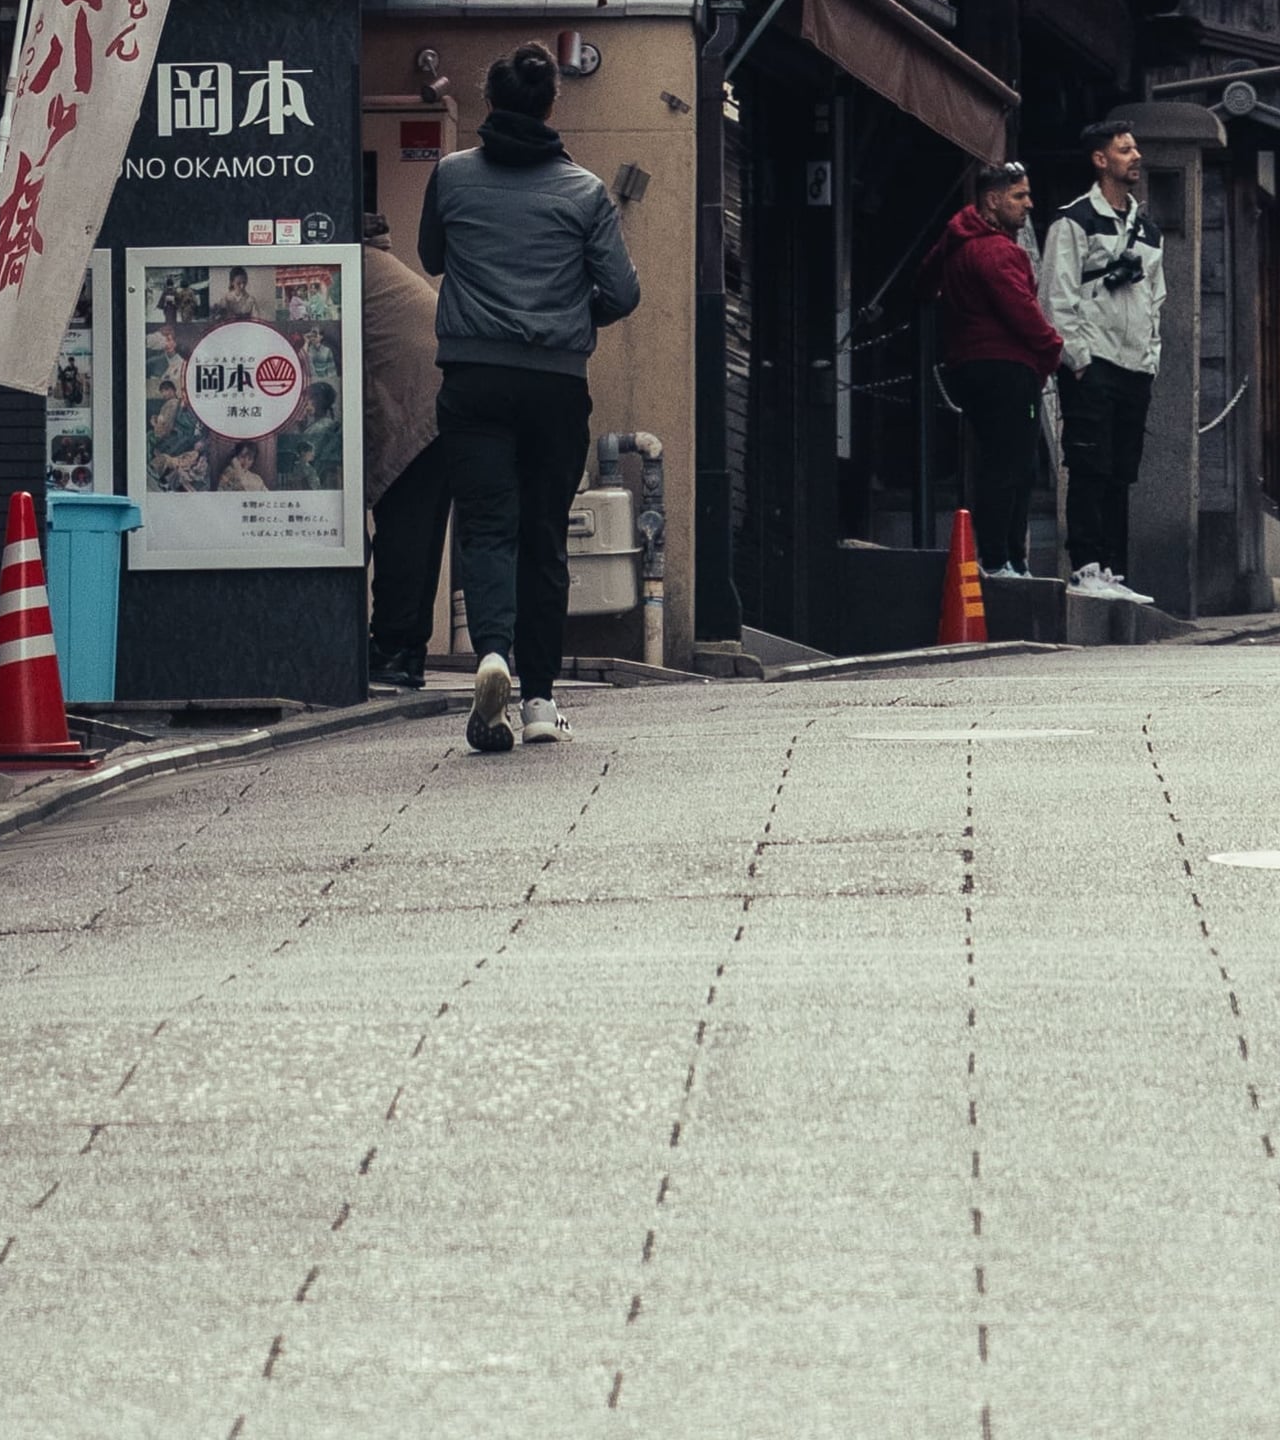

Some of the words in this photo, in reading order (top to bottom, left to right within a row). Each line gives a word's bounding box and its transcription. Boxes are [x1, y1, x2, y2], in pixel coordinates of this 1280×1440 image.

[157, 58, 315, 138] 岡本
[173, 154, 315, 179] OKAMOTO
[195, 363, 255, 393] 岡本
